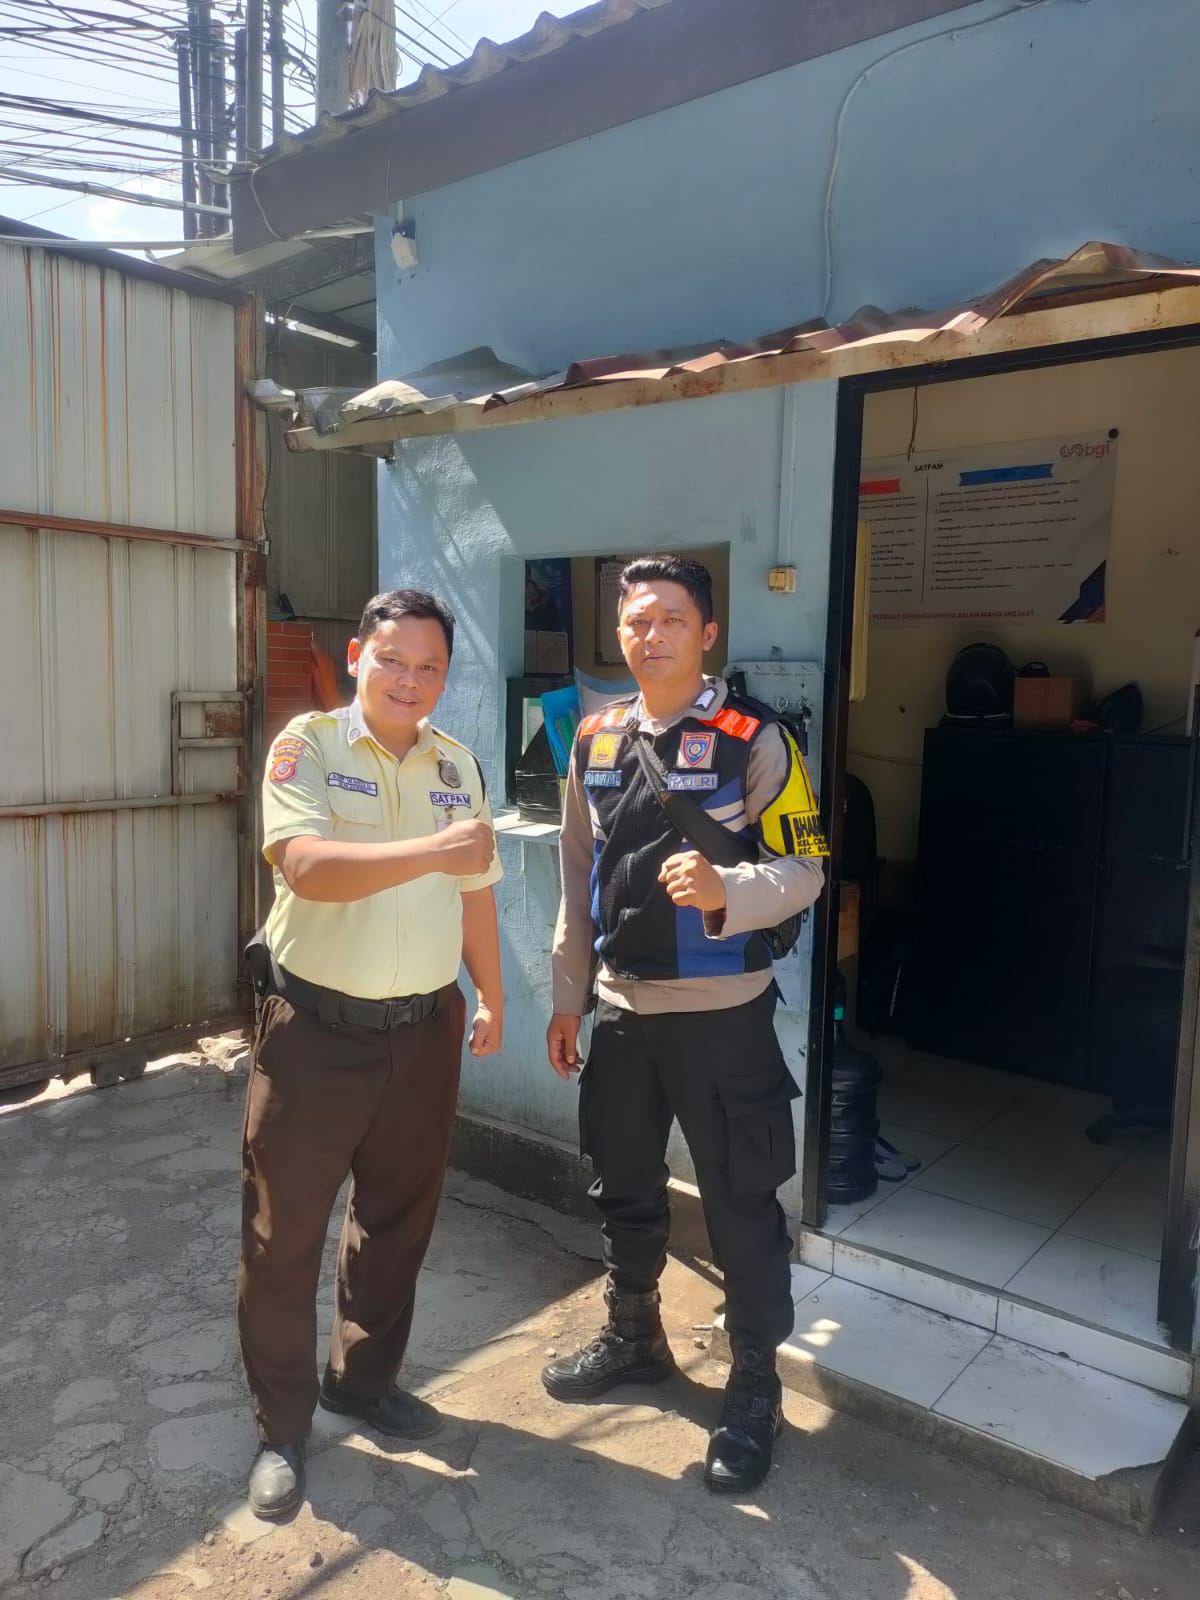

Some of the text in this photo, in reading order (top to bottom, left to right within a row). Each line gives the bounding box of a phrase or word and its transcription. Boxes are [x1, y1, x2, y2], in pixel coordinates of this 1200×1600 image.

[1085, 440, 1113, 458] bgi
[914, 462, 944, 472] SATPAM
[671, 776, 714, 787] POLRI
[431, 793, 470, 805] SATPAM
